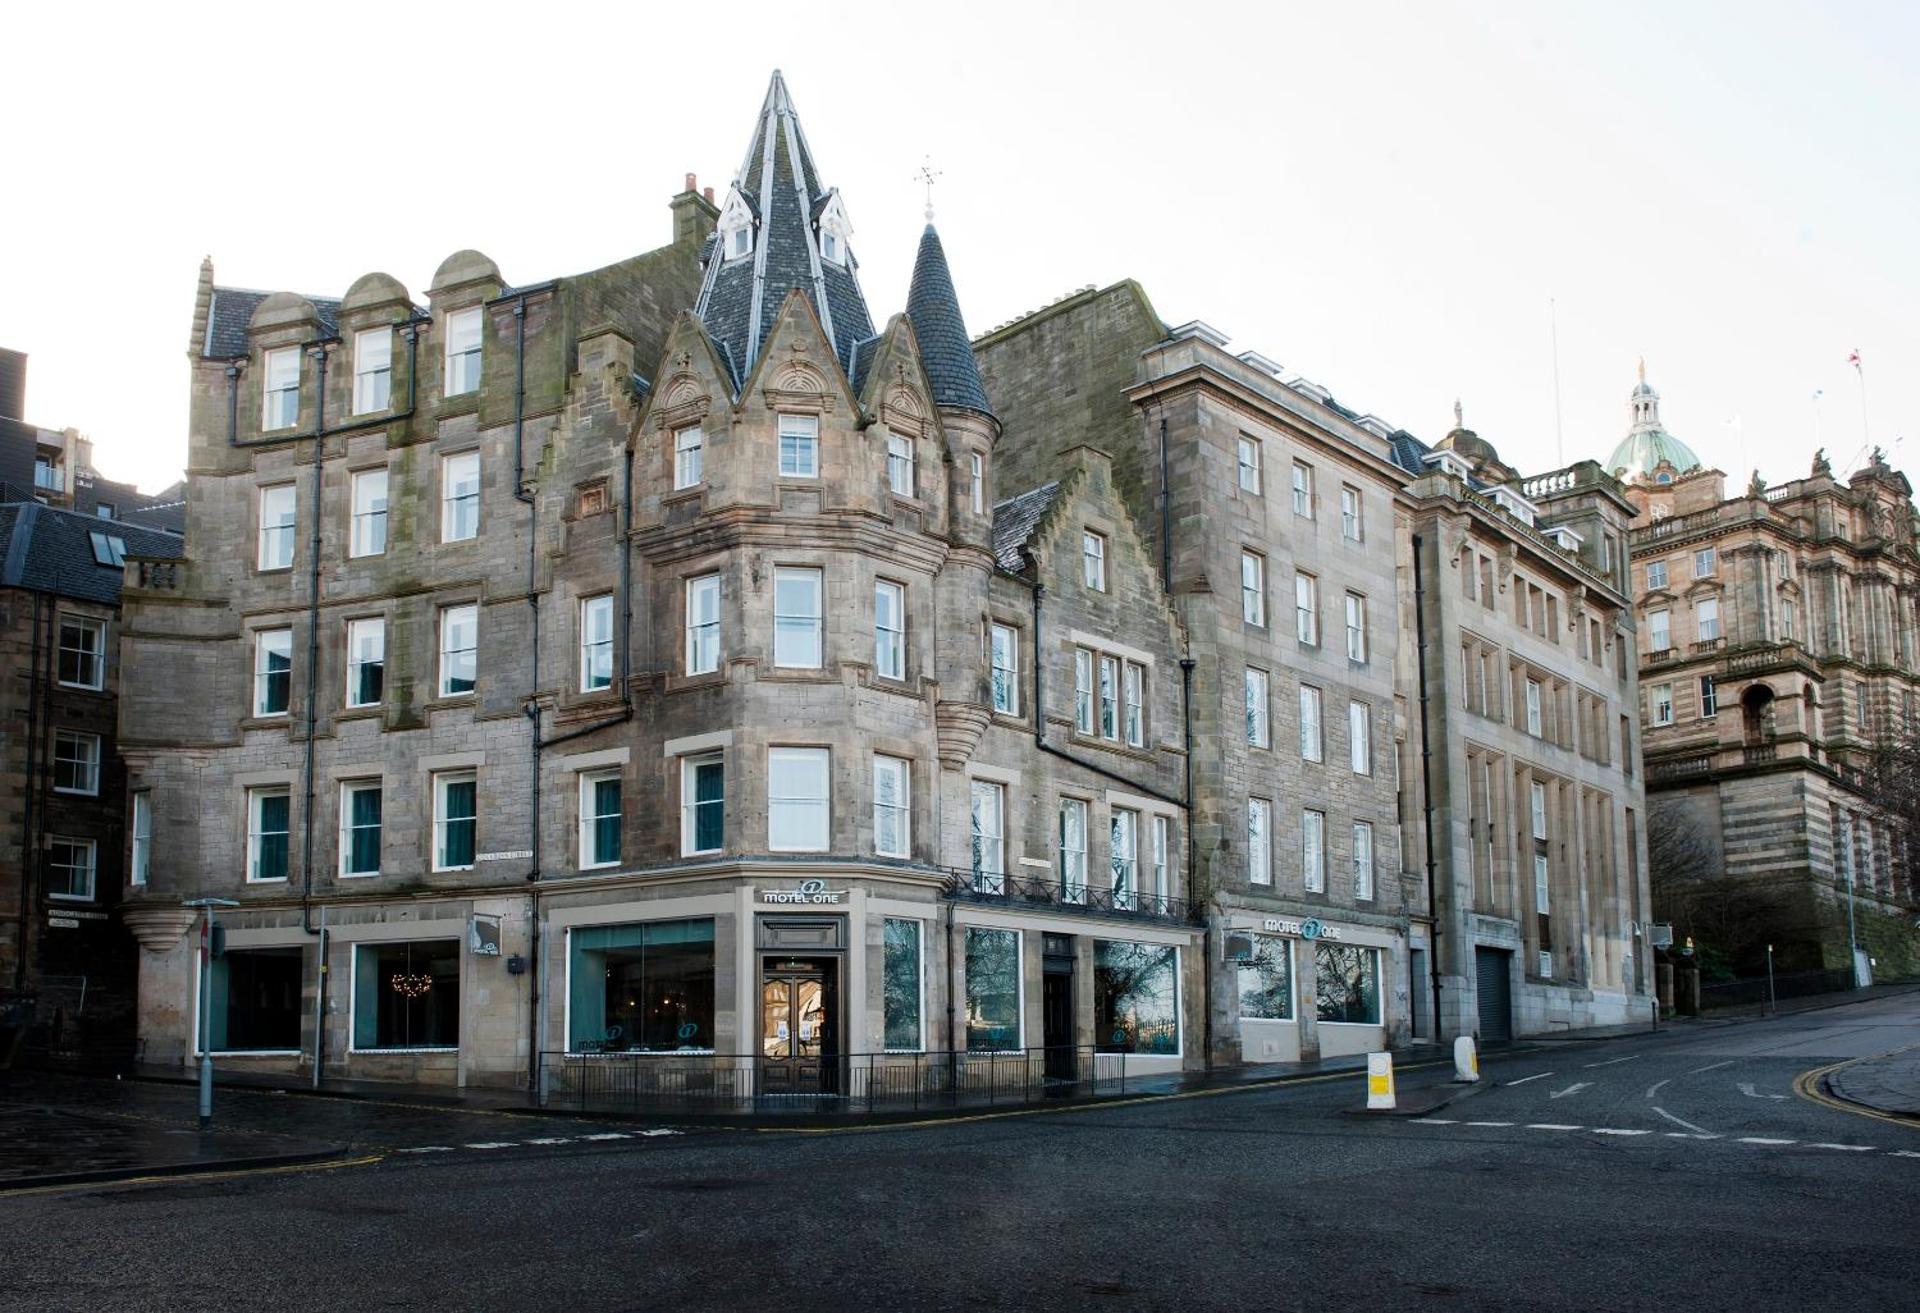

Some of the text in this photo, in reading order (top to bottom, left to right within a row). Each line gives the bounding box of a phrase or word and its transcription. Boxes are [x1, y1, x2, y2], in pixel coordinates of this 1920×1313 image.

[764, 893, 839, 903] MOTEL ONE
[1264, 920, 1340, 938] MOTEL ONE
